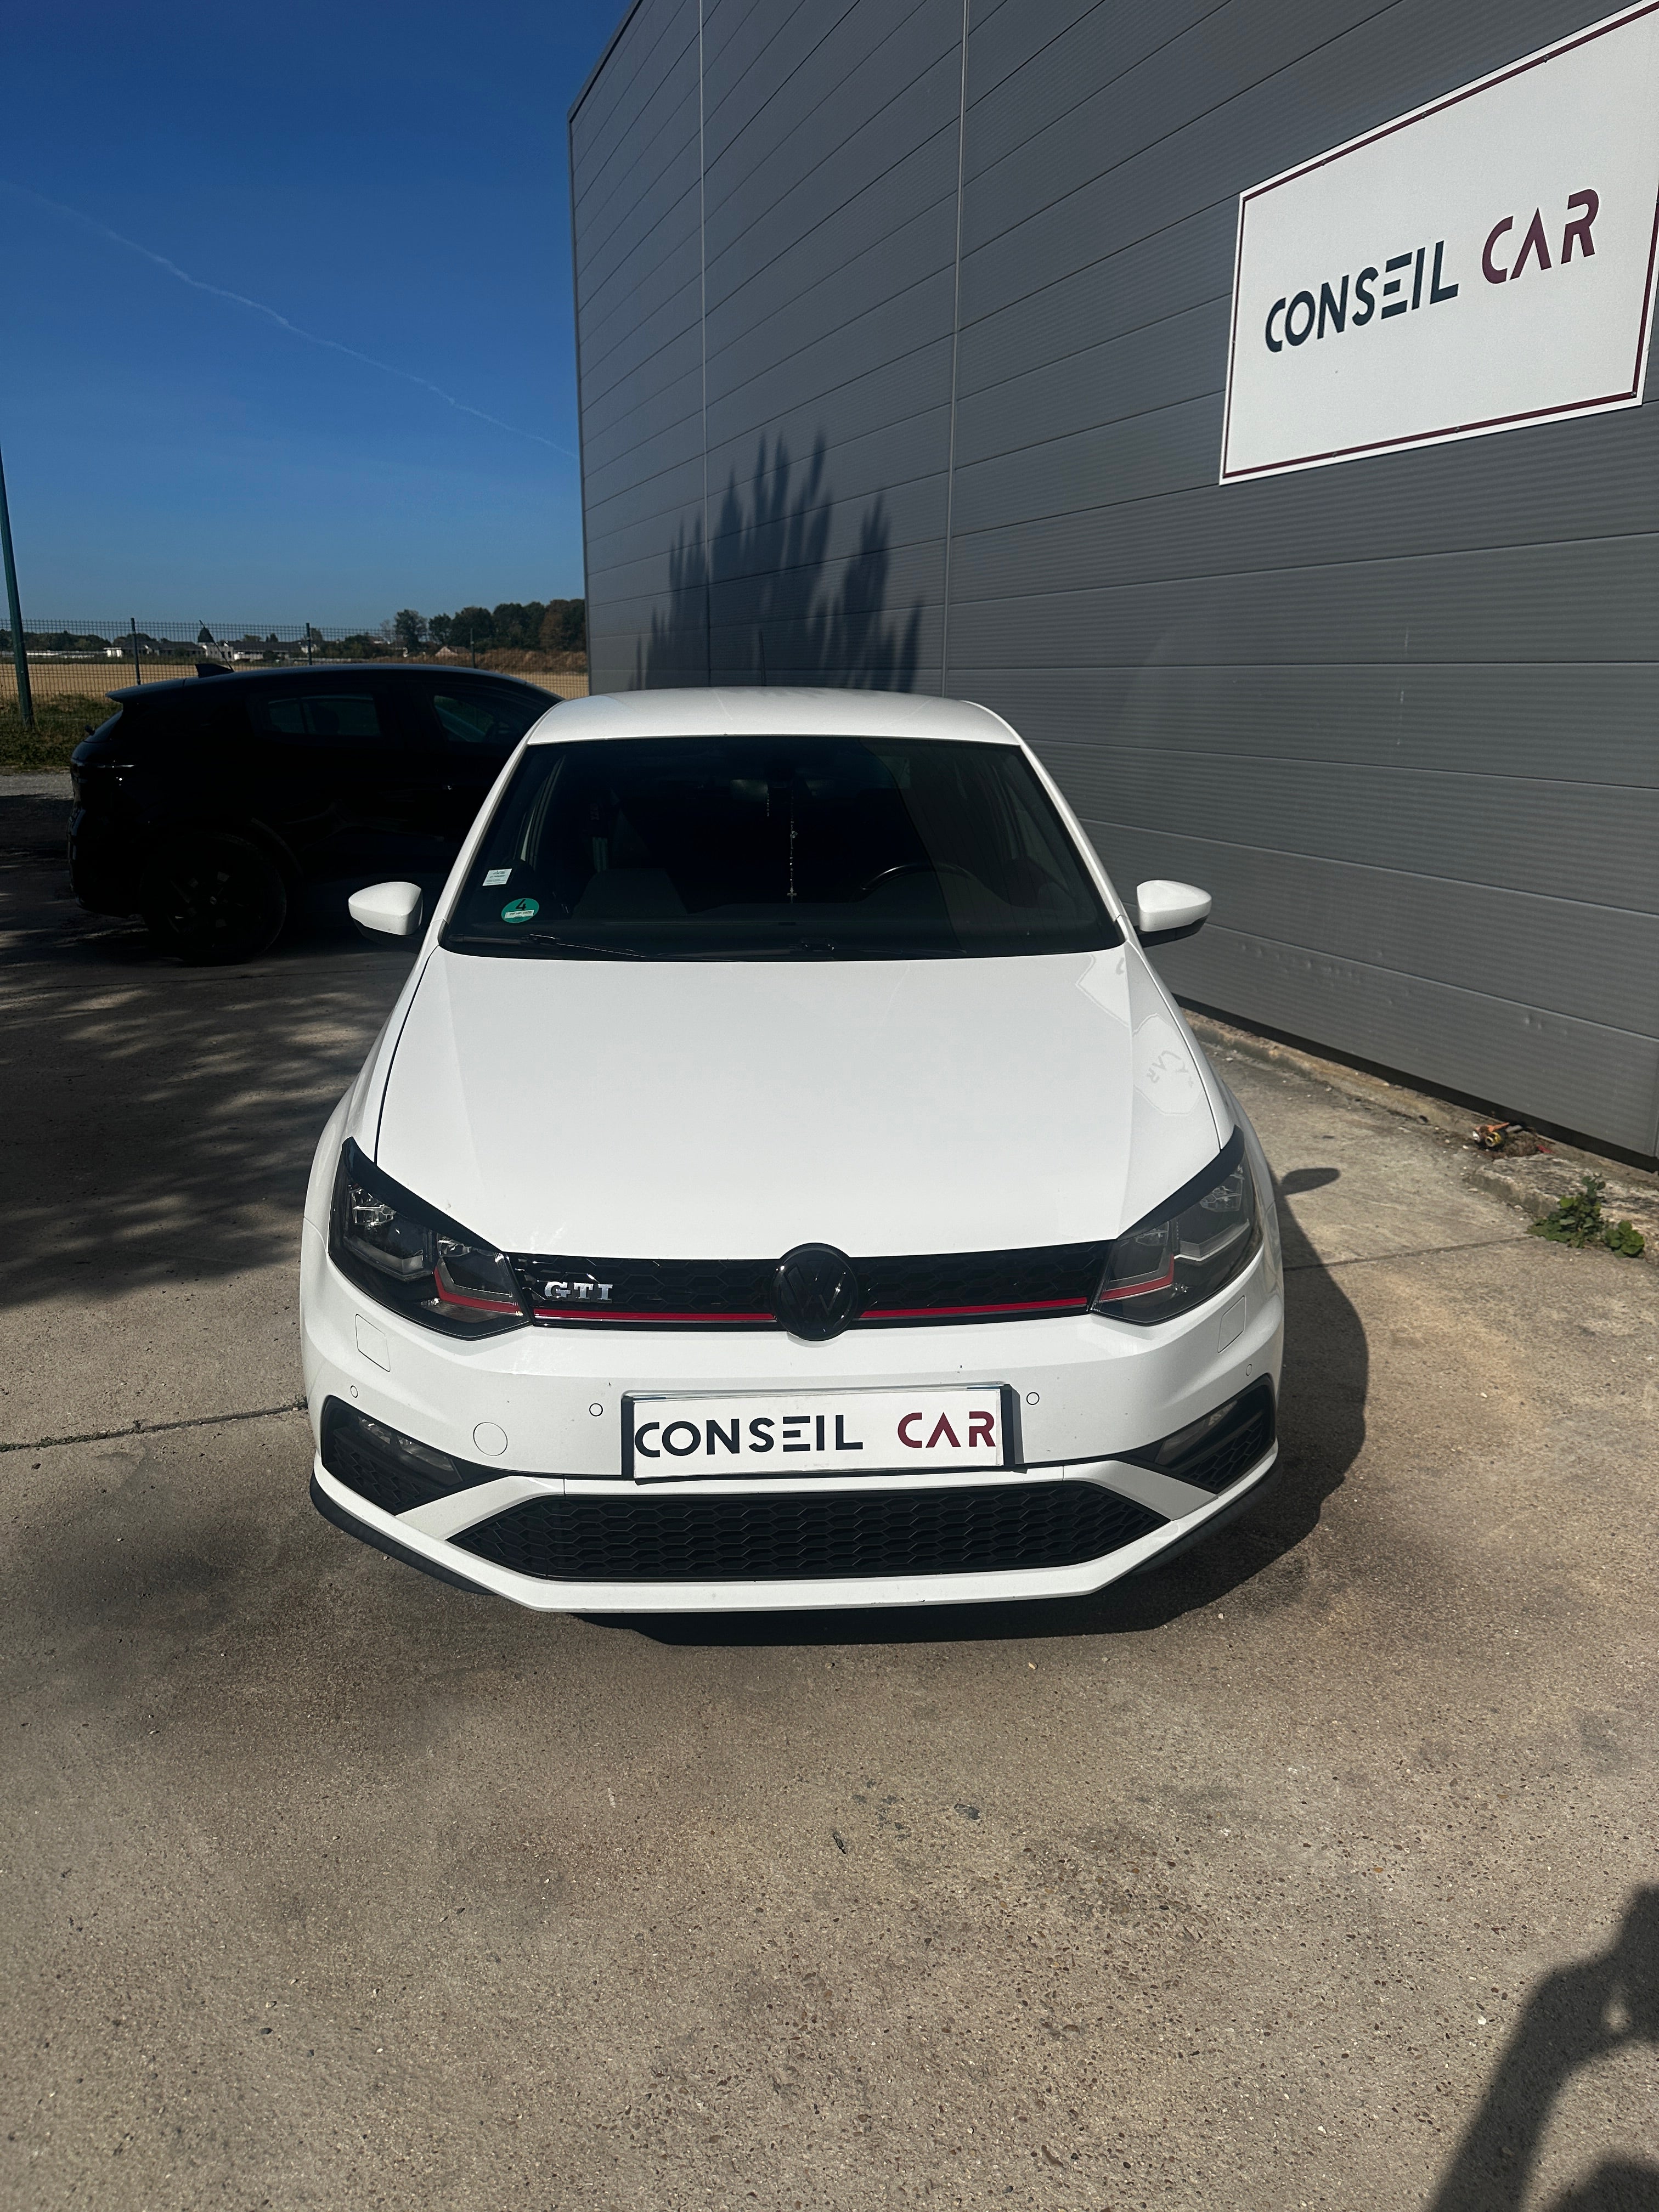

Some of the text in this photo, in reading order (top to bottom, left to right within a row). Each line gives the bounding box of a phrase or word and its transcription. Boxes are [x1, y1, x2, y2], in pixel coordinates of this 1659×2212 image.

[1265, 188, 1600, 353] CONSEIL CAR
[515, 899, 527, 911] 4
[544, 1280, 613, 1302] GTI
[634, 1410, 996, 1458] CONSEIL CAR
